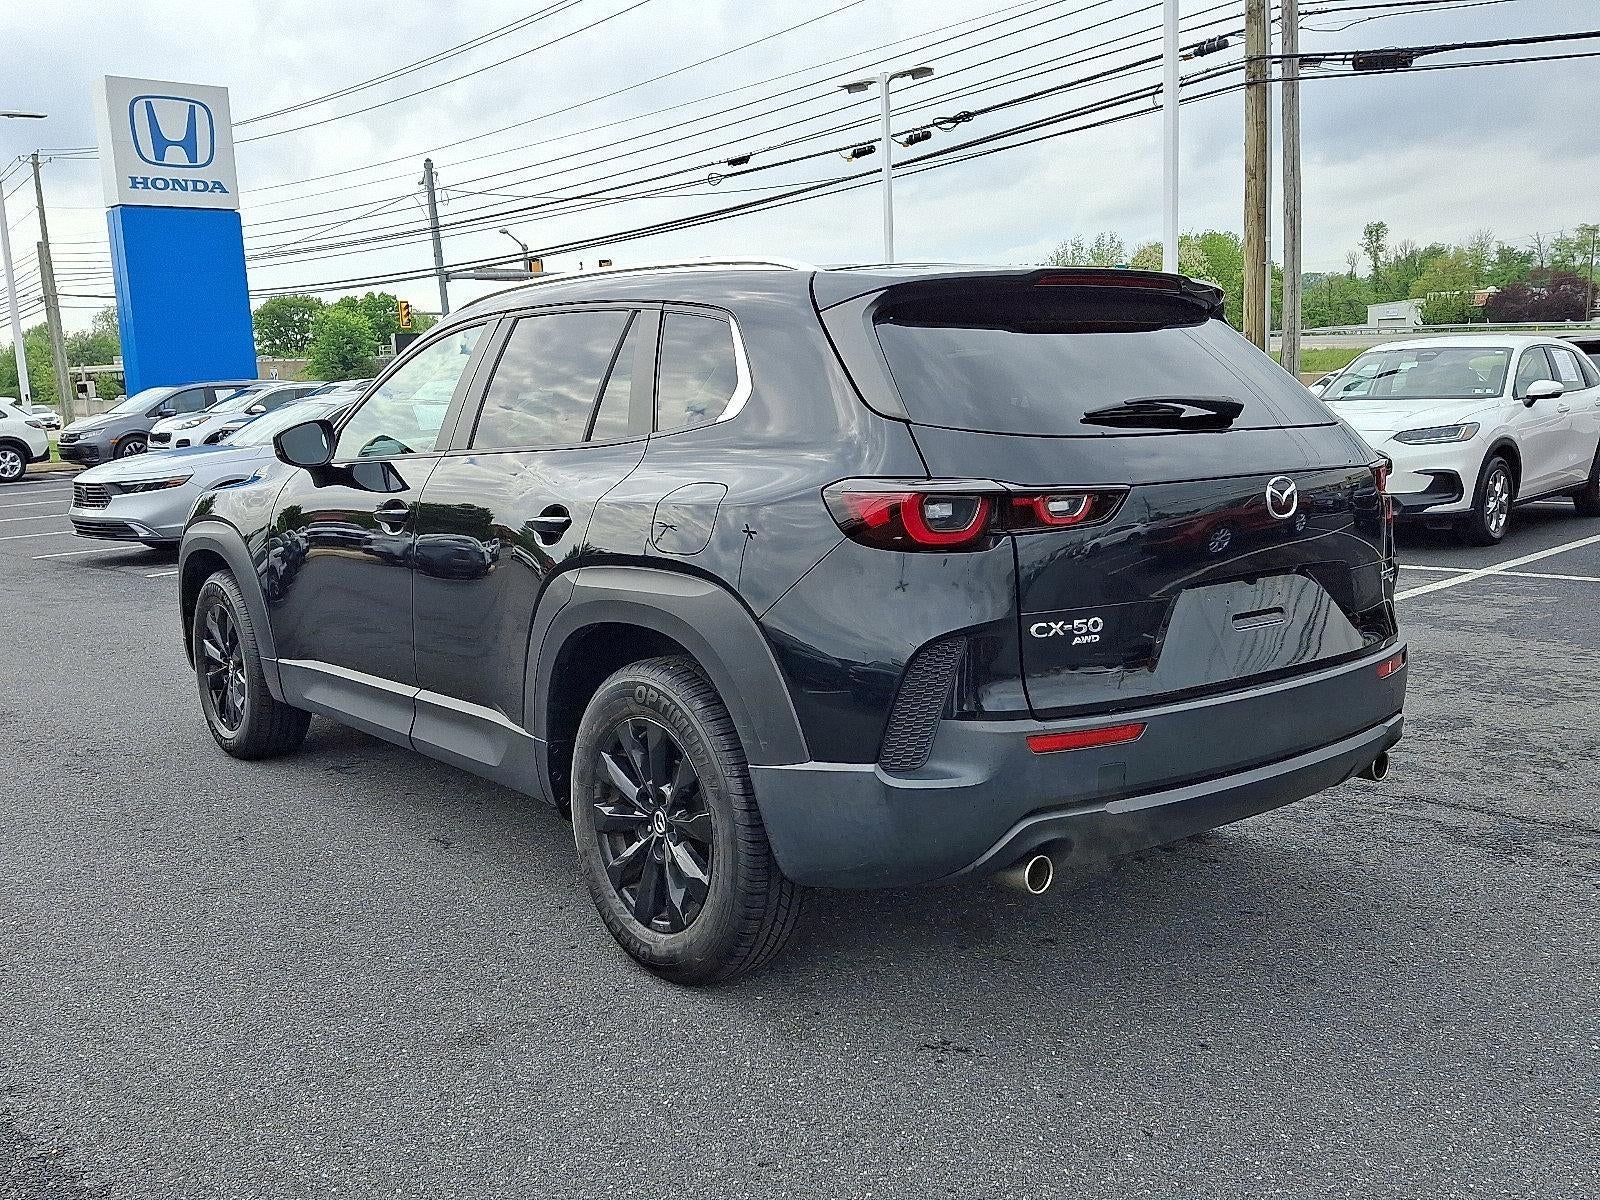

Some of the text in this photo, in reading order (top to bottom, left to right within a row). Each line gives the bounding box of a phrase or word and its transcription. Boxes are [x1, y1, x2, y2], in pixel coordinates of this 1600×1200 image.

[128, 175, 229, 194] HONDA
[1029, 616, 1104, 638] CX-50
[1071, 634, 1100, 646] AWD
